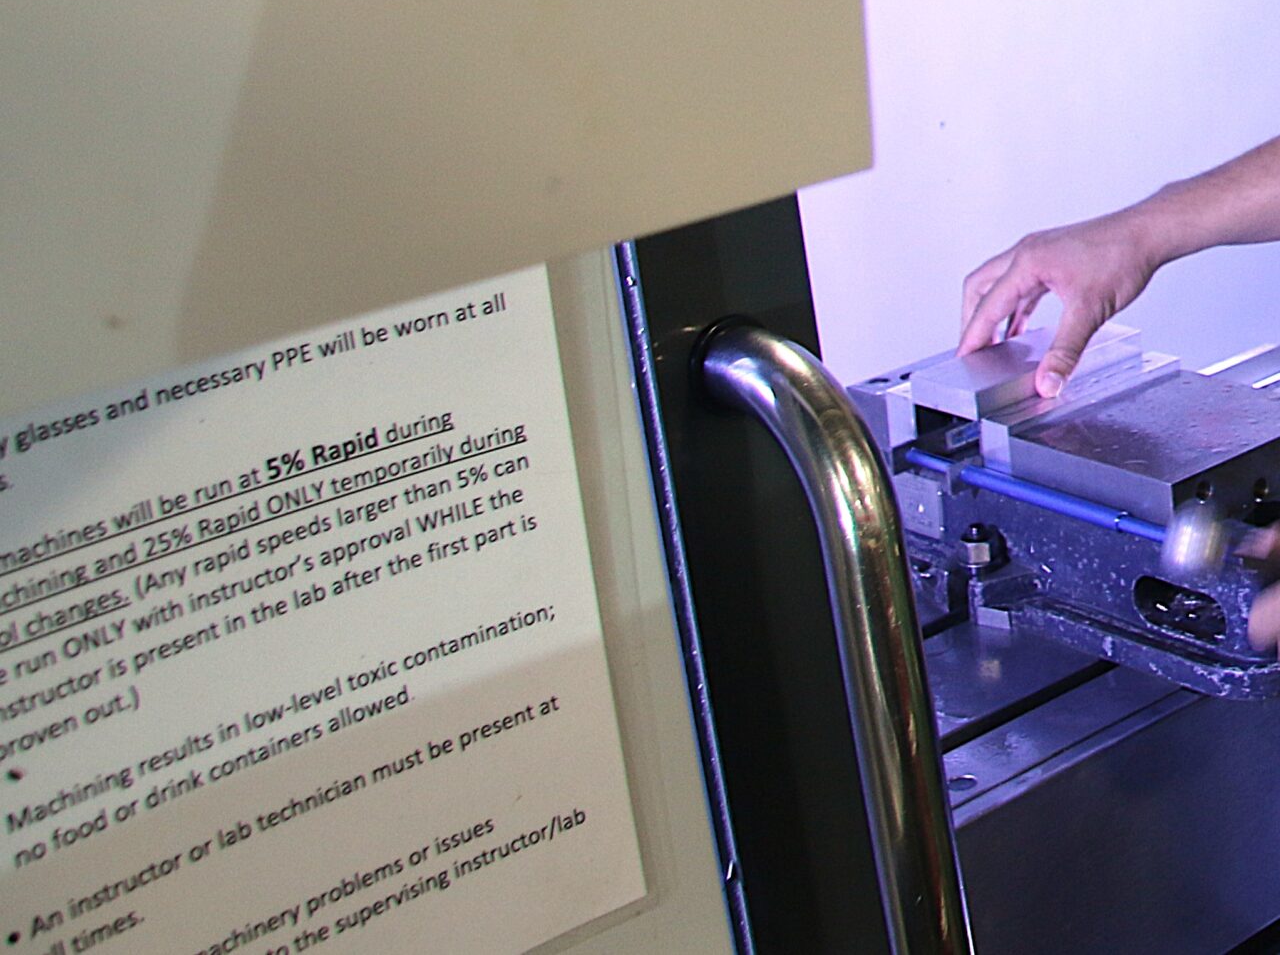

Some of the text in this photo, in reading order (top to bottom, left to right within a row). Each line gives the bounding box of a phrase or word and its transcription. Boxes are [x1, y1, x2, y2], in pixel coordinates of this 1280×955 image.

[14, 408, 100, 454] glasses
[106, 388, 149, 421] and
[155, 360, 266, 407] necessary
[271, 342, 313, 371] PPE
[318, 330, 356, 358] will
[361, 326, 388, 348] be
[394, 310, 450, 338] worn
[455, 302, 477, 323] at
[482, 291, 507, 315] all
[24, 590, 131, 638] changes.
[135, 564, 188, 600] (Any
[193, 539, 250, 578] rapid
[257, 516, 332, 555] speeds
[336, 495, 399, 527] larger
[403, 478, 452, 505] than
[457, 465, 489, 488] 5%
[494, 455, 530, 478] can
[94, 542, 138, 575] and
[143, 525, 194, 558] 25%
[199, 501, 260, 539] Rapid
[267, 479, 324, 515] ONLY
[330, 444, 454, 493] temporarily
[459, 424, 527, 456] during
[113, 498, 154, 531] will
[159, 493, 188, 516] be
[194, 477, 233, 504] run
[239, 468, 262, 490] at
[266, 449, 305, 480] 5%
[311, 426, 379, 465] Rapid
[385, 412, 455, 444] during
[14, 651, 58, 679] run
[62, 618, 126, 660] ONLY
[132, 600, 184, 633] with
[319, 520, 413, 568] approval
[416, 497, 484, 533] WHILE
[489, 487, 525, 511] the
[109, 657, 128, 679] is
[133, 622, 222, 675] present
[225, 612, 247, 635] in
[251, 599, 289, 626] the
[293, 583, 326, 610] lab
[332, 564, 383, 597] after
[387, 553, 423, 577] the
[427, 535, 470, 563] first
[474, 519, 518, 550] part
[521, 512, 538, 532] is
[6, 603, 556, 834] Machining results in low-level toxic contamination;
[83, 685, 141, 726] out.)
[14, 841, 48, 869] no
[52, 808, 110, 850] food
[114, 797, 140, 824] or
[144, 768, 205, 810] drink
[209, 721, 323, 783] containers
[31, 695, 561, 940] An instructor or lab technician must be present at
[305, 858, 405, 918] problems
[408, 844, 430, 869] or
[434, 816, 496, 856] issues
[71, 909, 146, 954] times.
[293, 924, 331, 953] the
[335, 868, 451, 934] supervising
[453, 807, 588, 880] instructor/lab
